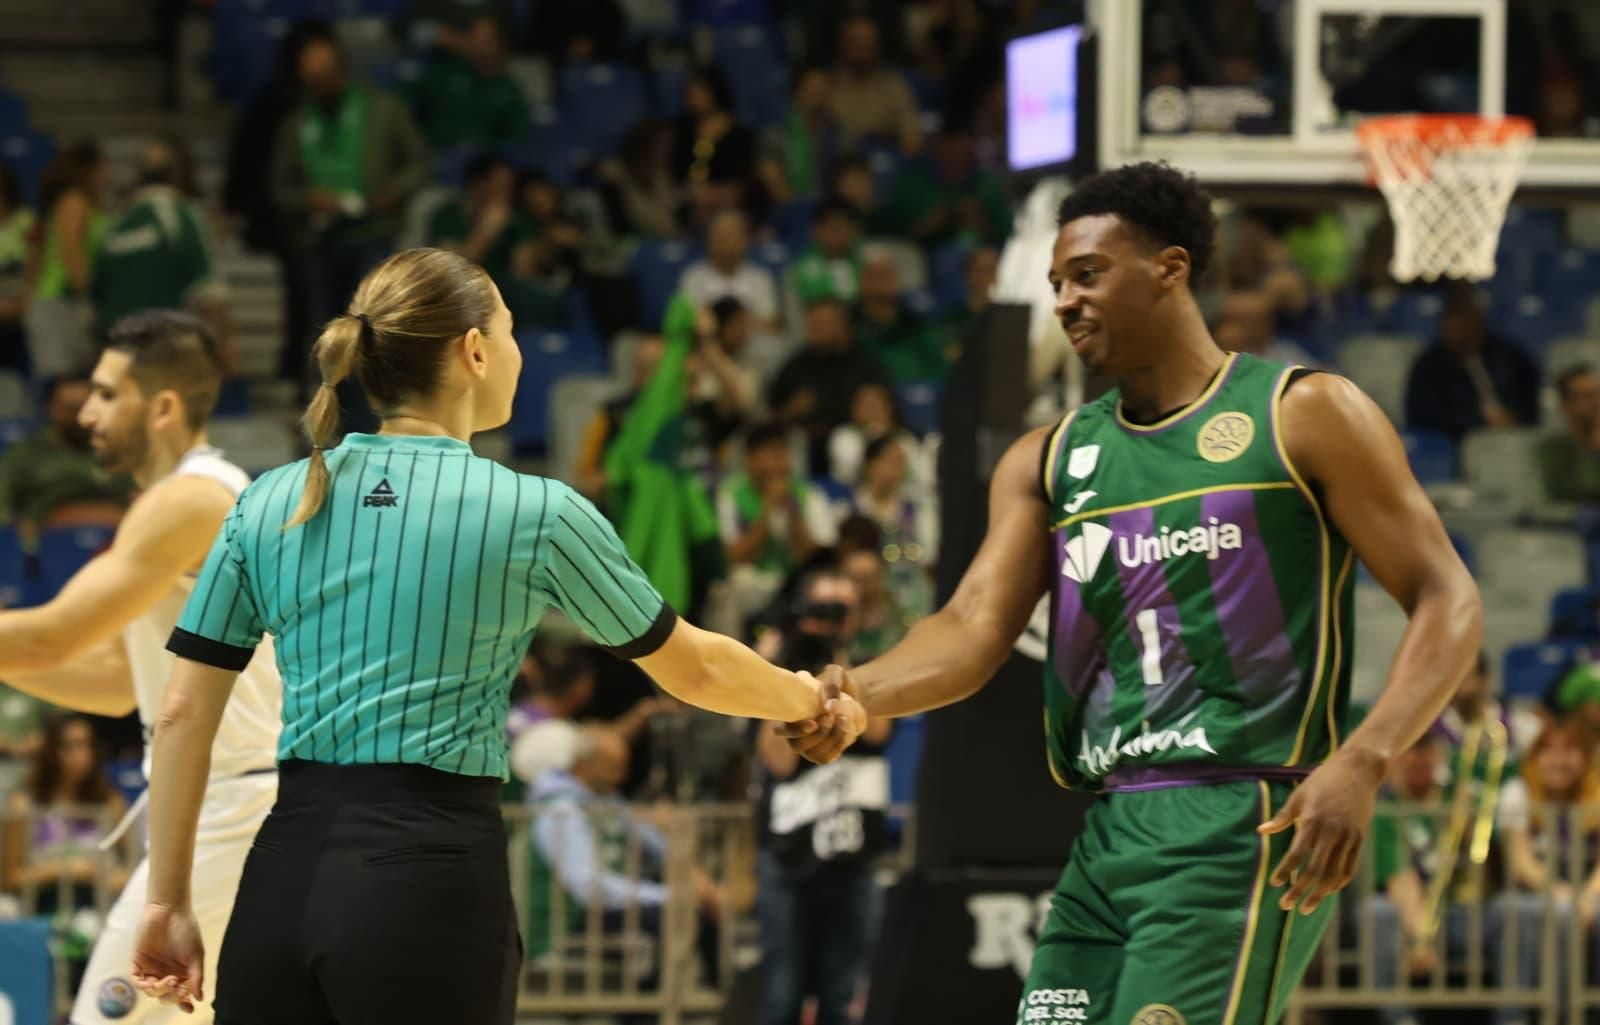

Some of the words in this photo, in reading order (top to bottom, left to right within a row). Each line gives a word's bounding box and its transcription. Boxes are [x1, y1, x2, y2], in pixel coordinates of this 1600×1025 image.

[363, 495, 399, 508] PEAK
[1118, 516, 1242, 568] Unicaja
[1136, 608, 1163, 685] 1
[1027, 988, 1089, 1005] COSTA
[1024, 1006, 1051, 1021] DEL
[1053, 1006, 1087, 1019] SOL
